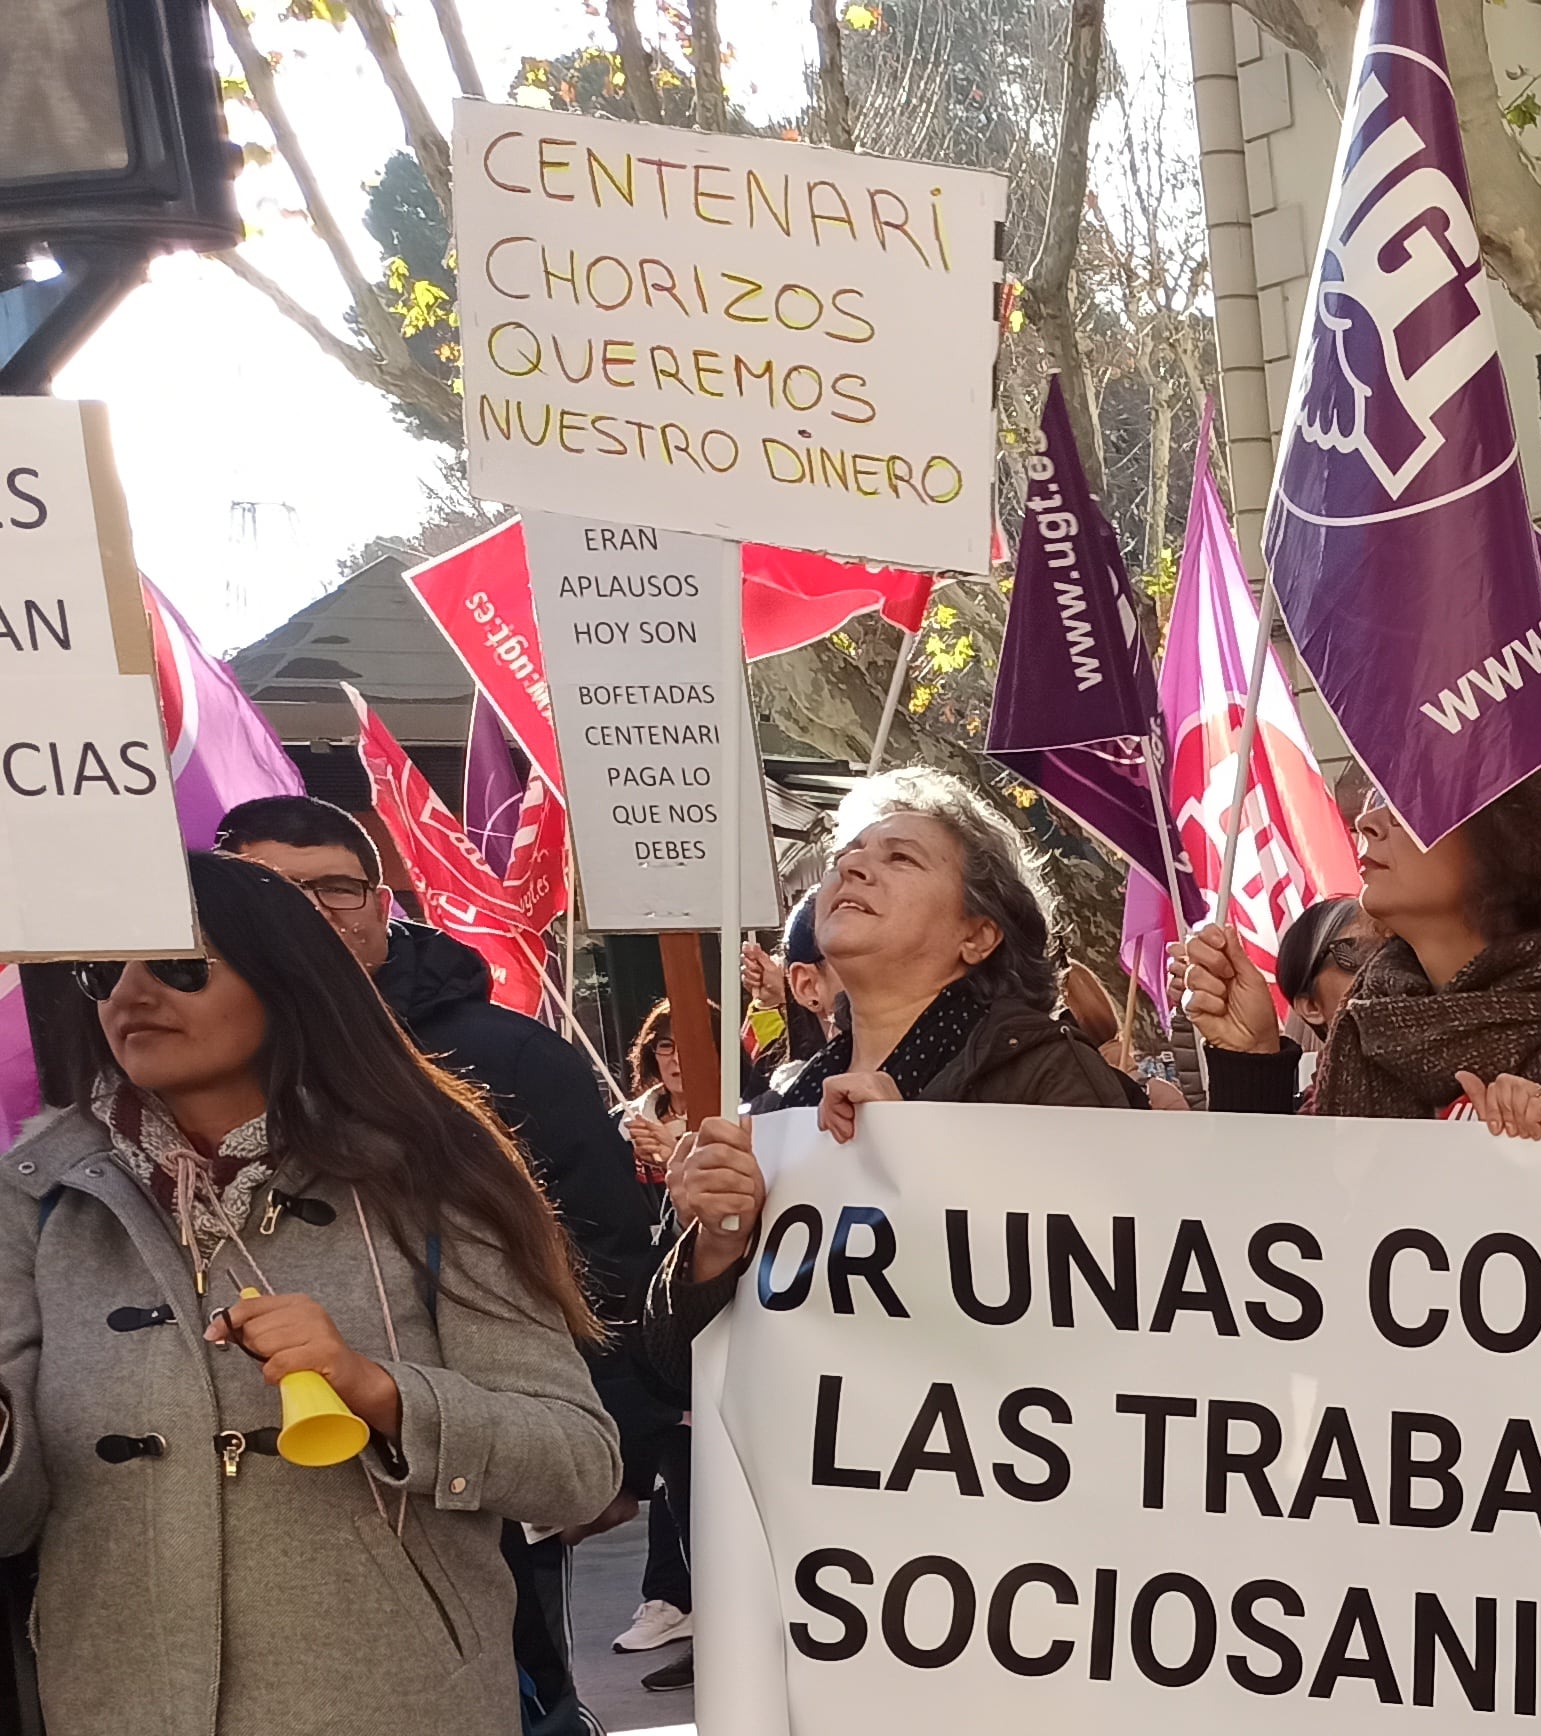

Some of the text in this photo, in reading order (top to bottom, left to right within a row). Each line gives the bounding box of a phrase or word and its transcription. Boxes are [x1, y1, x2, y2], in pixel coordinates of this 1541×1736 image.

[485, 236, 875, 343] CHORIZOS
[488, 321, 877, 423] QUEREMOS
[479, 395, 739, 473] NUESTRO
[584, 527, 659, 551] ERAN
[559, 574, 700, 598] APLAUSOS
[574, 620, 698, 646] HOY SON
[579, 684, 716, 706] BOFETADAS
[584, 725, 721, 746] CENTENARI
[607, 766, 711, 788] PAGA LO
[612, 804, 719, 826] QUE NOS
[635, 841, 707, 862] DEBES
[944, 1206, 1325, 1342] UNAS
[811, 1374, 1073, 1503] LAS
